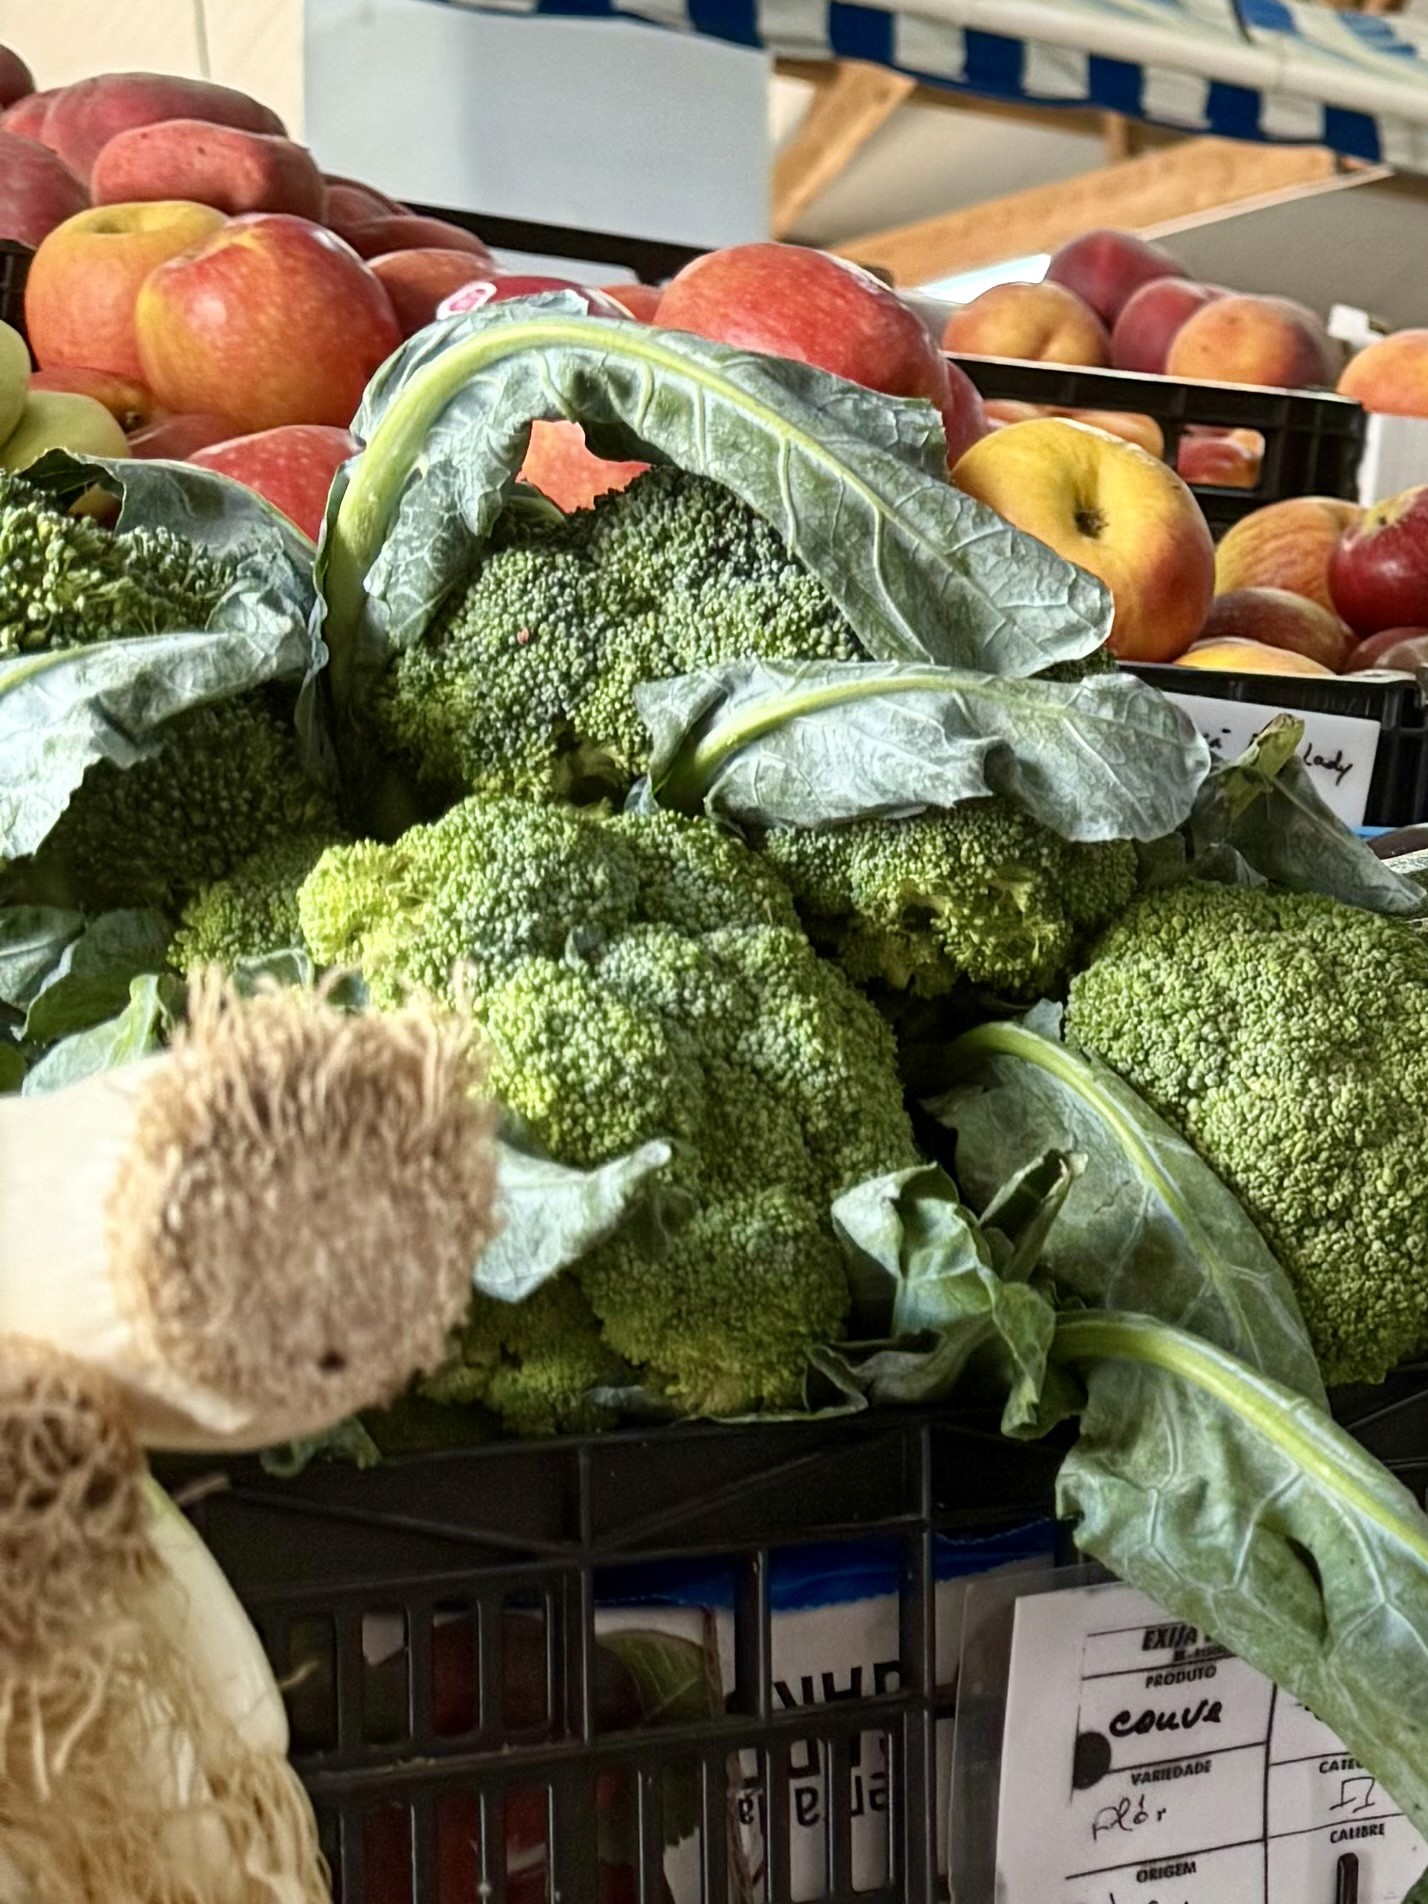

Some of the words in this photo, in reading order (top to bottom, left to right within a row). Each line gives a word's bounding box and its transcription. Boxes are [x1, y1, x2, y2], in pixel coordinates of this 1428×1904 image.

[1303, 742, 1353, 786] Lady
[1142, 1624, 1199, 1651] EXIJA
[1145, 1665, 1217, 1689] PRODUTO
[1131, 1760, 1212, 1785] VARIEDADE
[1330, 1823, 1385, 1844] CALIBRE
[1135, 1861, 1197, 1883] ORIGEM
